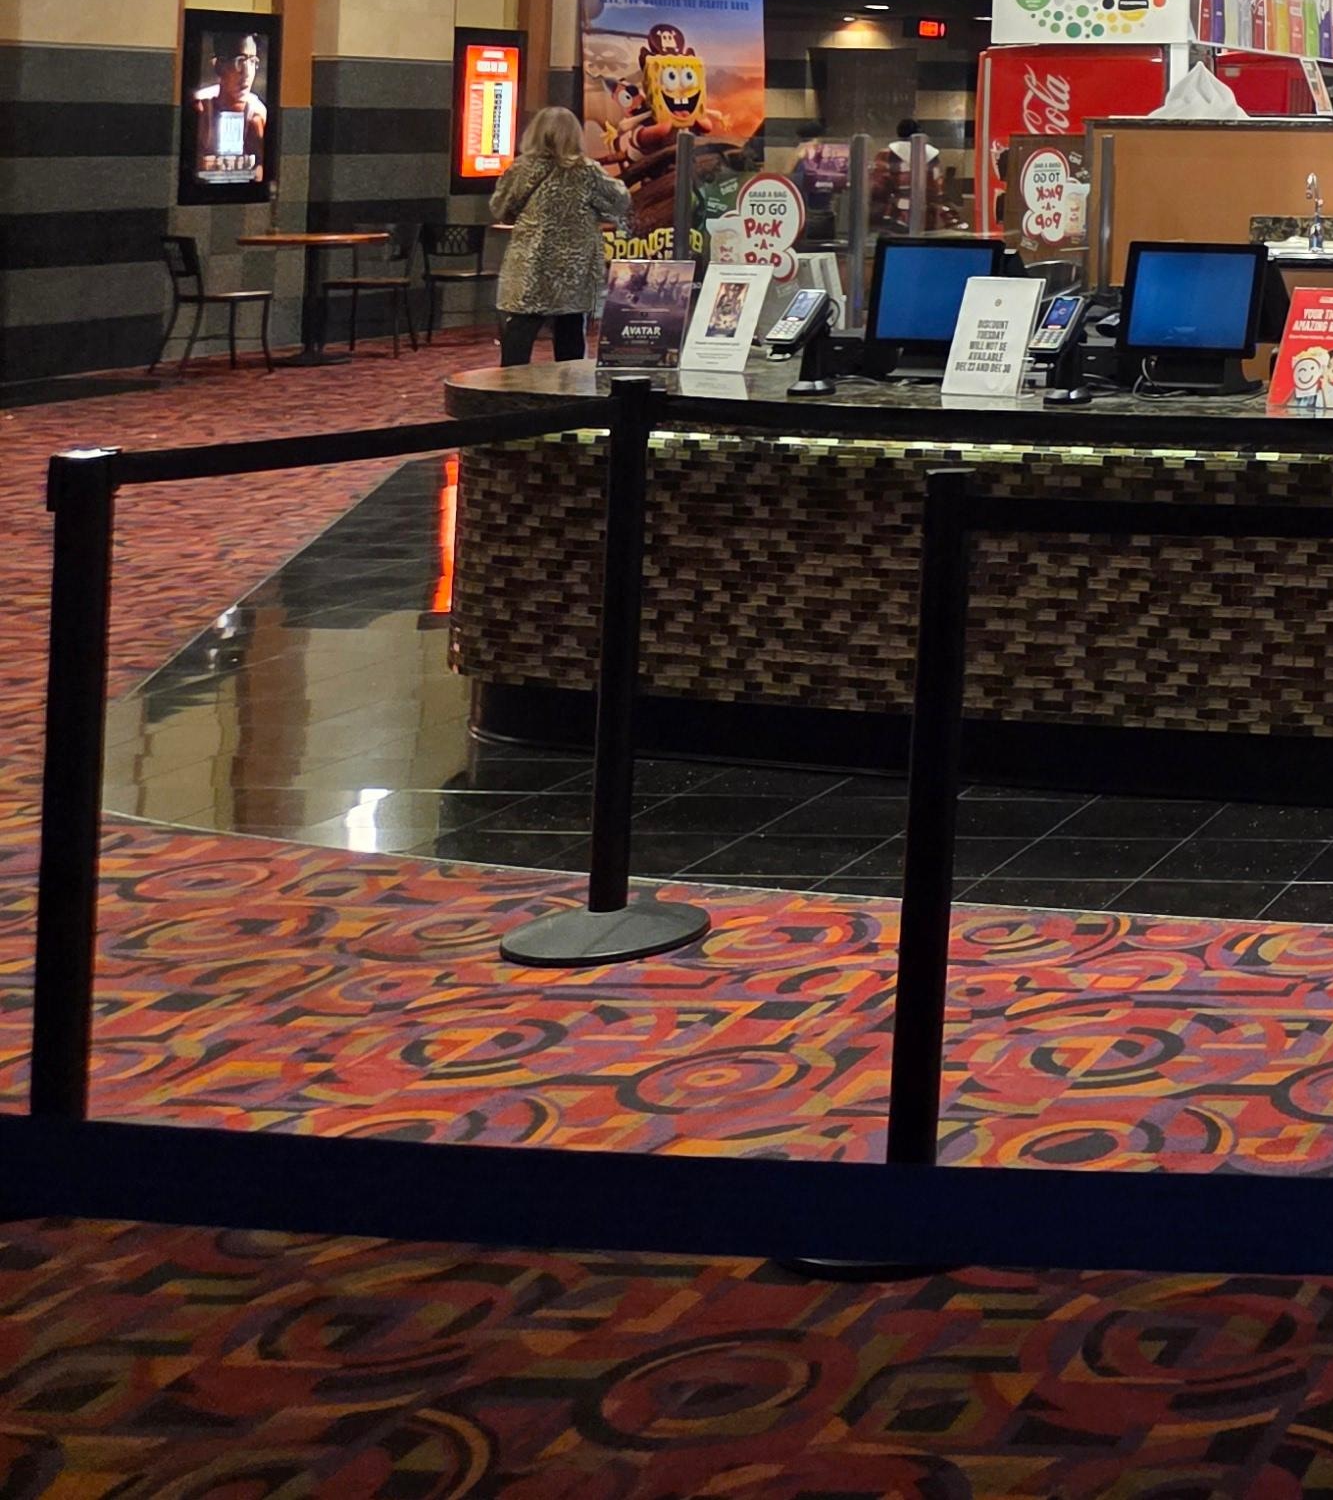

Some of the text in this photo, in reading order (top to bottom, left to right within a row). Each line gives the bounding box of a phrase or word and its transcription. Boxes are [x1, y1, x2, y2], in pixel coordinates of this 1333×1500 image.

[750, 203, 787, 215] TO GO
[744, 218, 783, 238] PACK
[1304, 308, 1324, 320] YOUR
[977, 319, 1009, 330] DISCOUNT
[1292, 321, 1328, 332] AMAZING
[622, 326, 661, 336] AVATAR
[976, 330, 1005, 340] TUESDAY
[969, 341, 1007, 351] WILL NOT BE
[967, 352, 1003, 362] AVAILABLE
[954, 362, 966, 371] DEC
[976, 363, 989, 372] AND
[990, 363, 1001, 373] DEC
